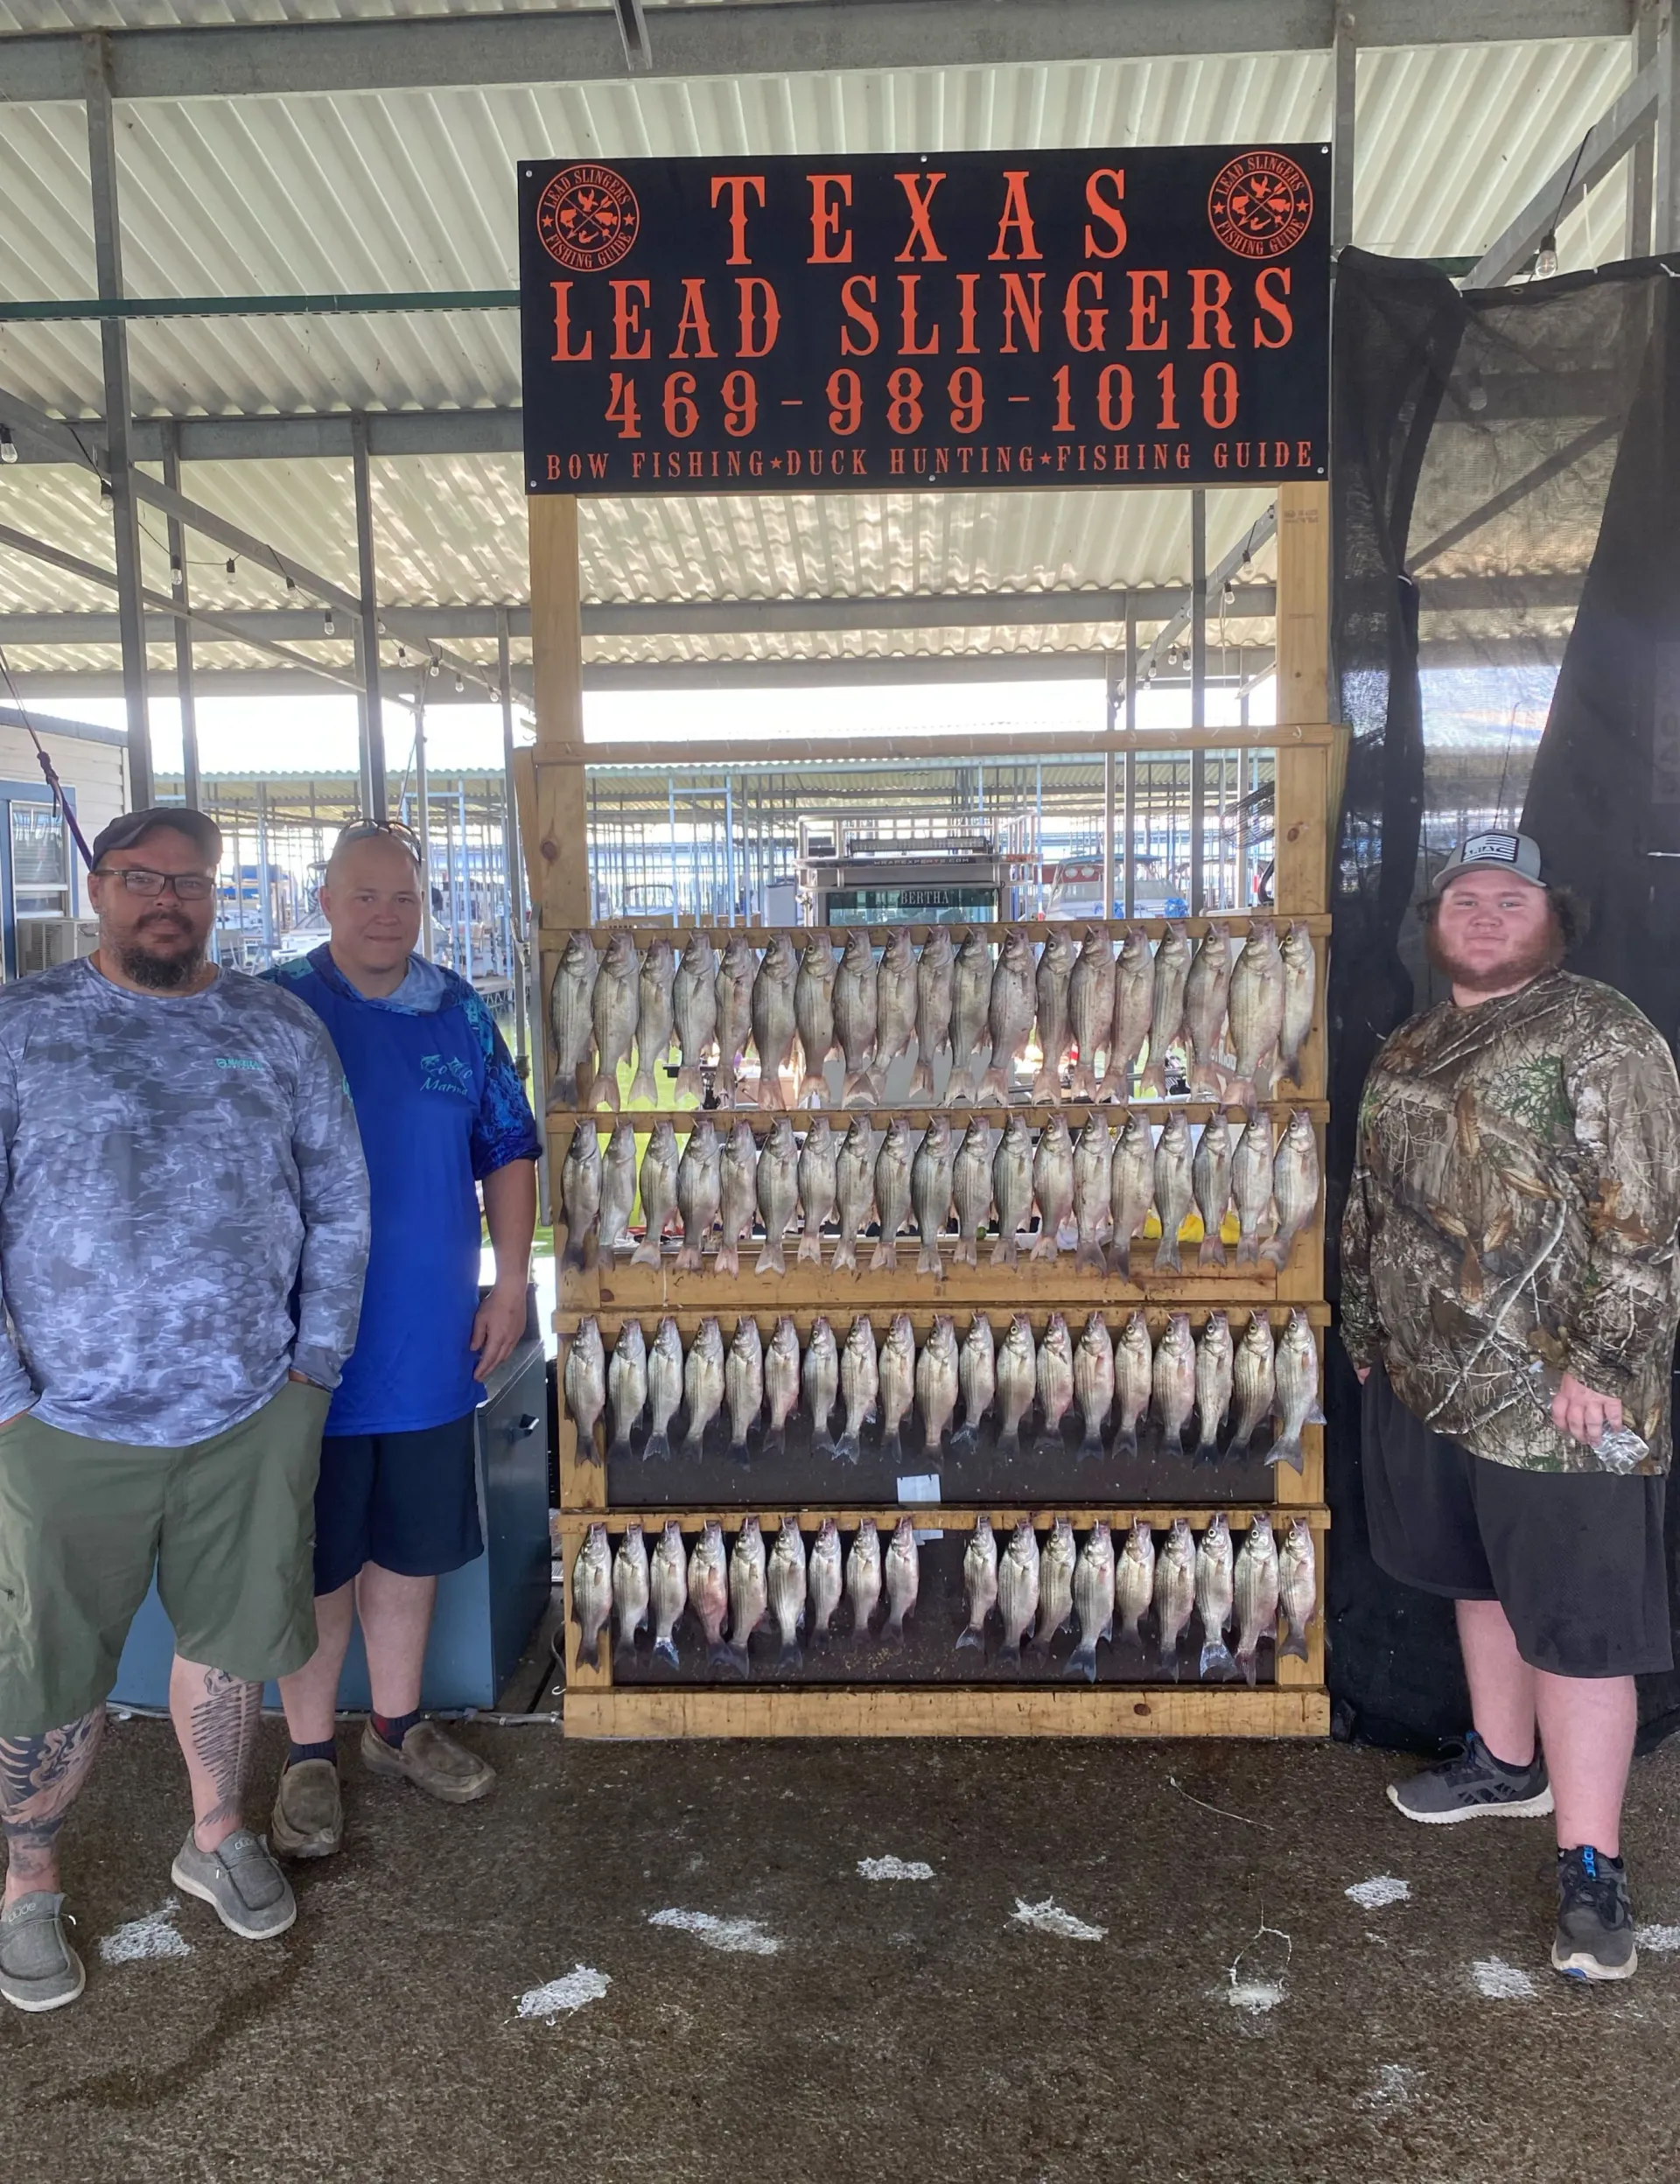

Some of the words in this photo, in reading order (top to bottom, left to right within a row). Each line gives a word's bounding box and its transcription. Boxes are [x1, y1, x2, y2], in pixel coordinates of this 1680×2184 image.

[543, 177, 571, 209] LEAD
[574, 169, 632, 205] SLINGERS
[1215, 164, 1243, 195] LEAD
[1248, 156, 1305, 191] SLINGERS
[711, 169, 1126, 264] TEXAS
[546, 234, 592, 268] FISHING
[598, 232, 632, 265] GUIDE
[1216, 220, 1264, 256] FISHING
[1270, 218, 1305, 252] GUIDE
[550, 278, 780, 360] LEAD
[842, 268, 1292, 355] SLINGERS
[606, 361, 1240, 438] 469-989-1010
[548, 453, 609, 480] BOW
[634, 452, 761, 476] FISHING
[788, 450, 864, 474] DUCK
[892, 448, 1032, 472] HUNTING
[1059, 444, 1188, 469] FISHING
[1214, 442, 1310, 466] GUIDE
[900, 891, 949, 905] BERTHA
[420, 1077, 468, 1096] Marina
